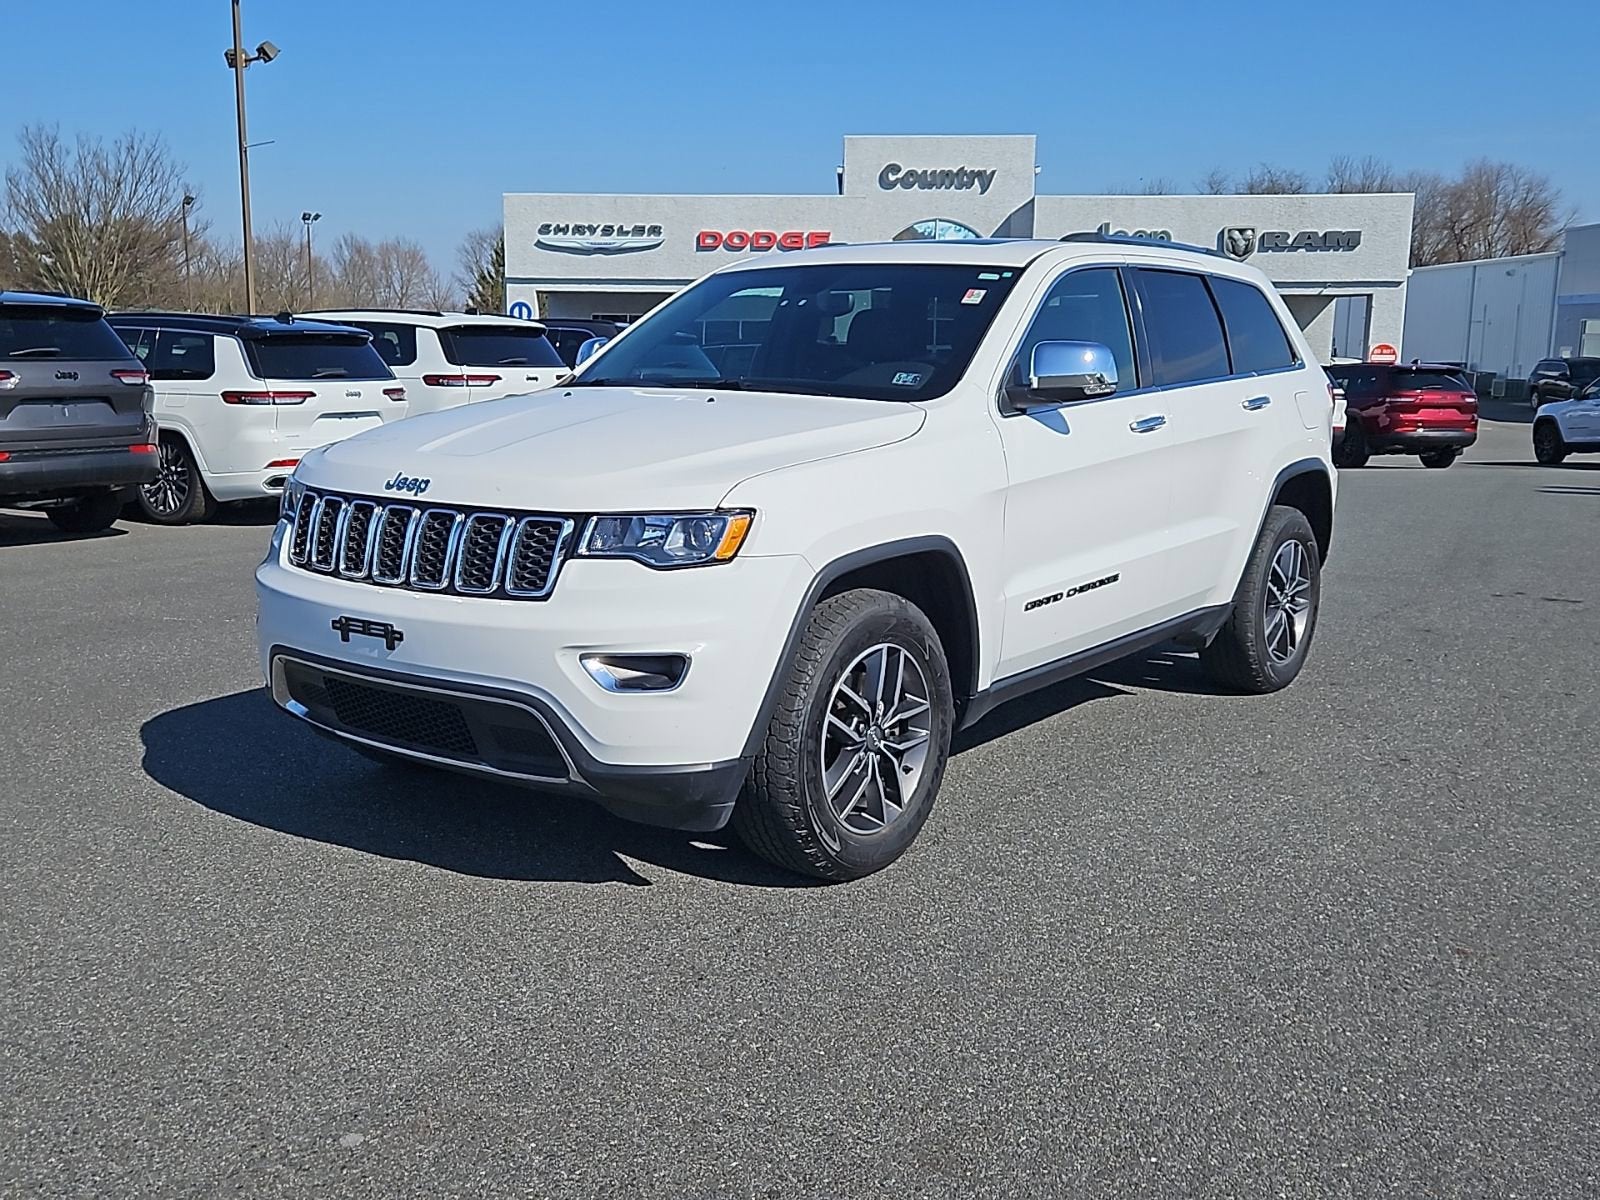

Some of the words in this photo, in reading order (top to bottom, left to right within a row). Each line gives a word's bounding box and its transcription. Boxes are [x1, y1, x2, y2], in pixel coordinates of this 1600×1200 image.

[878, 163, 997, 195] Country
[537, 223, 662, 237] CHRYSLER
[696, 231, 831, 252] DODGE
[1257, 230, 1362, 253] RAM
[384, 471, 431, 497] Jeep
[1024, 592, 1064, 612] GRAND
